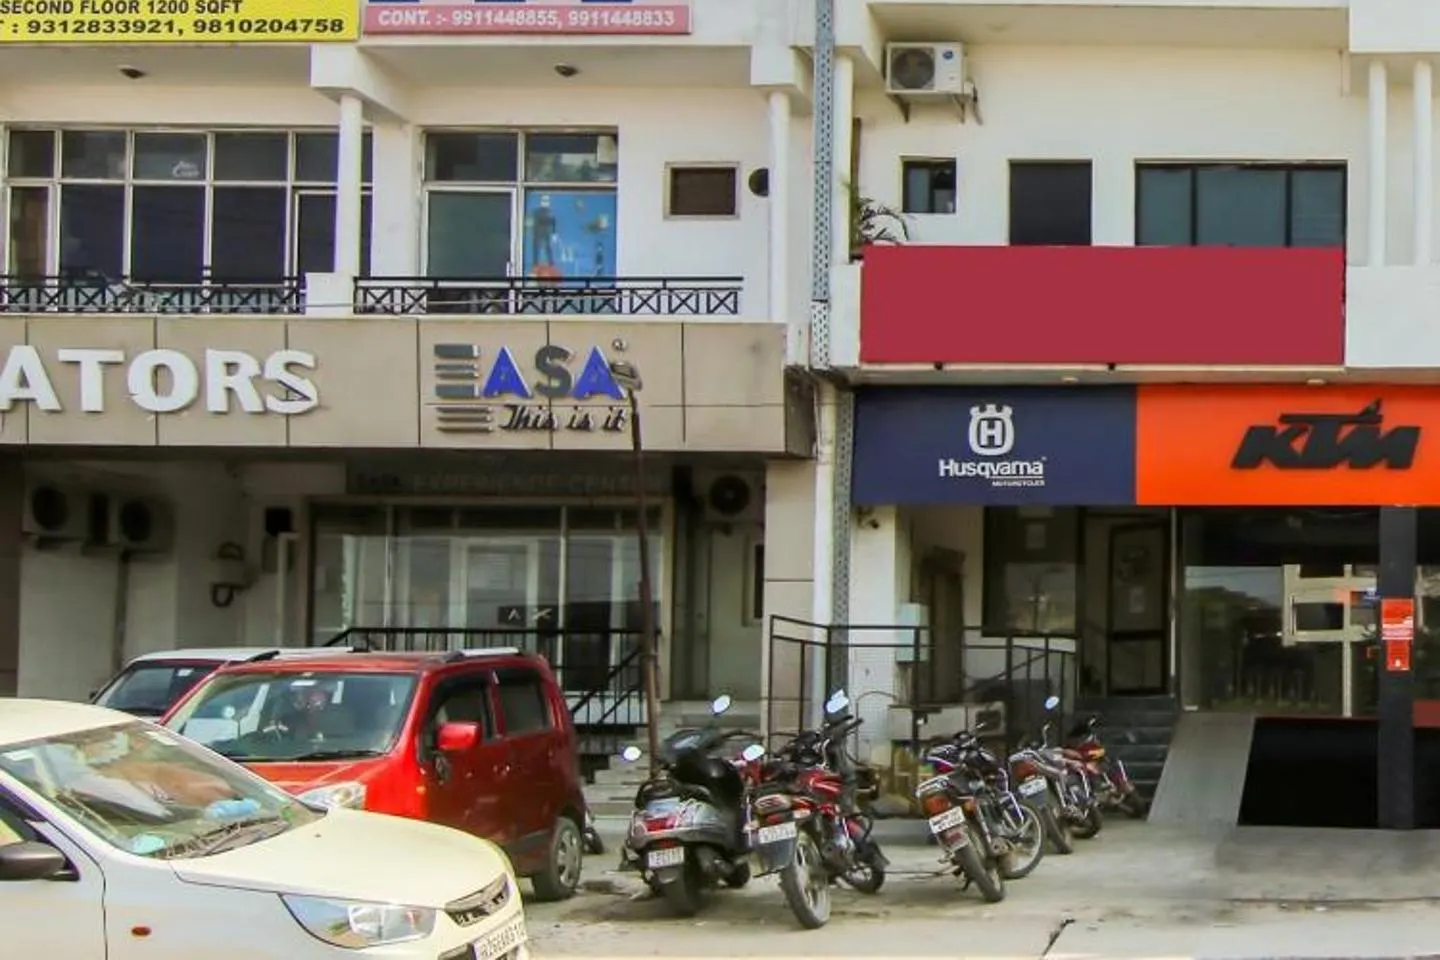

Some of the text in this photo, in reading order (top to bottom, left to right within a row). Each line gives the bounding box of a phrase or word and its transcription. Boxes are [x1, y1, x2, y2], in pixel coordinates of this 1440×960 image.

[0, 0, 243, 14] SECOND FLOOR 1200 SQFT
[27, 20, 184, 36] 9312833921,
[193, 19, 345, 33] 9810204758
[378, 10, 431, 27] CONT.
[0, 344, 320, 415] ATORS
[500, 403, 626, 431] This is it
[1230, 397, 1421, 469] KTM
[939, 458, 1044, 479] Husqvarna
